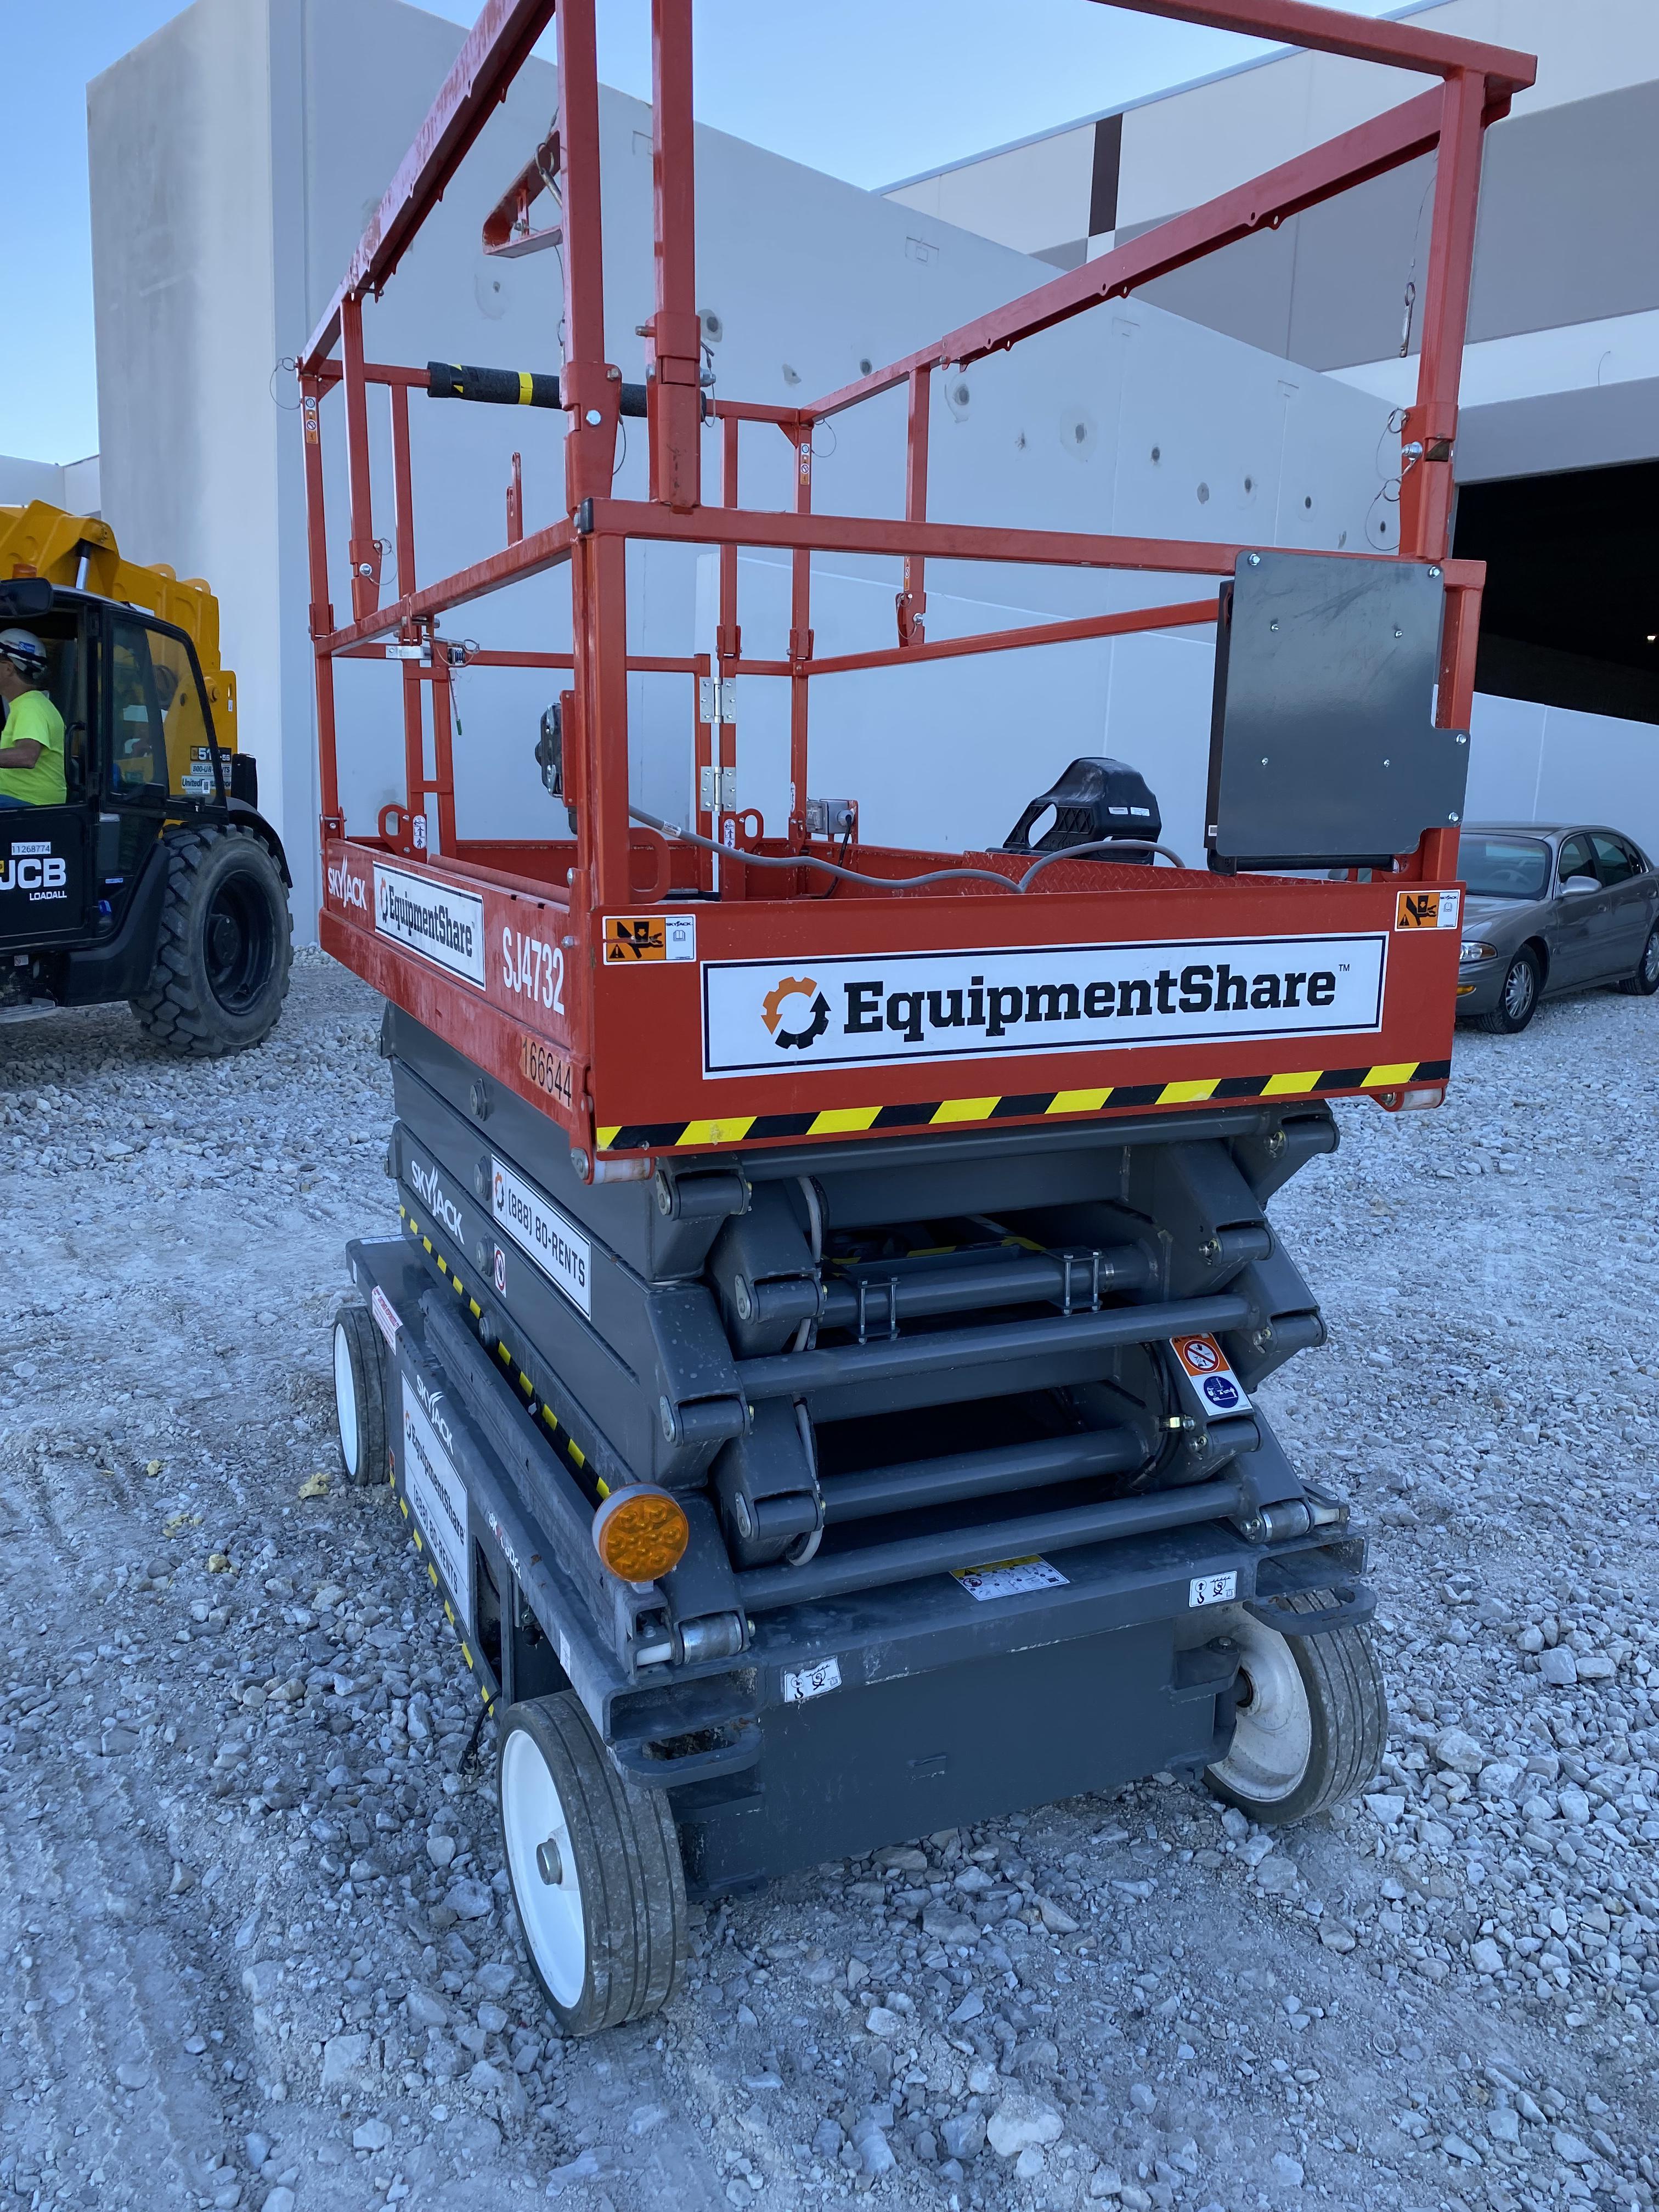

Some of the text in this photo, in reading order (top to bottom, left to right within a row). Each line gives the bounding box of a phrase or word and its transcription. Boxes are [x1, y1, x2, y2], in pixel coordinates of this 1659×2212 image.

[0, 858, 66, 890] JCB
[12, 845, 50, 853] 11268774
[328, 854, 367, 911] SKYJACK
[30, 891, 67, 901] LOADALL
[388, 885, 473, 958] EquipmentShare
[503, 927, 565, 1015] SJ4732
[843, 964, 1336, 1043] EquipmentShare
[523, 1037, 572, 1107] 166644
[411, 1160, 465, 1245] SKYJACK
[509, 1188, 585, 1288] (888) 80-RENTS
[416, 1374, 454, 1456] SKYJACK
[411, 1423, 464, 1546] EquipmentShare
[414, 1484, 458, 1595] (888) 80-RENTS
